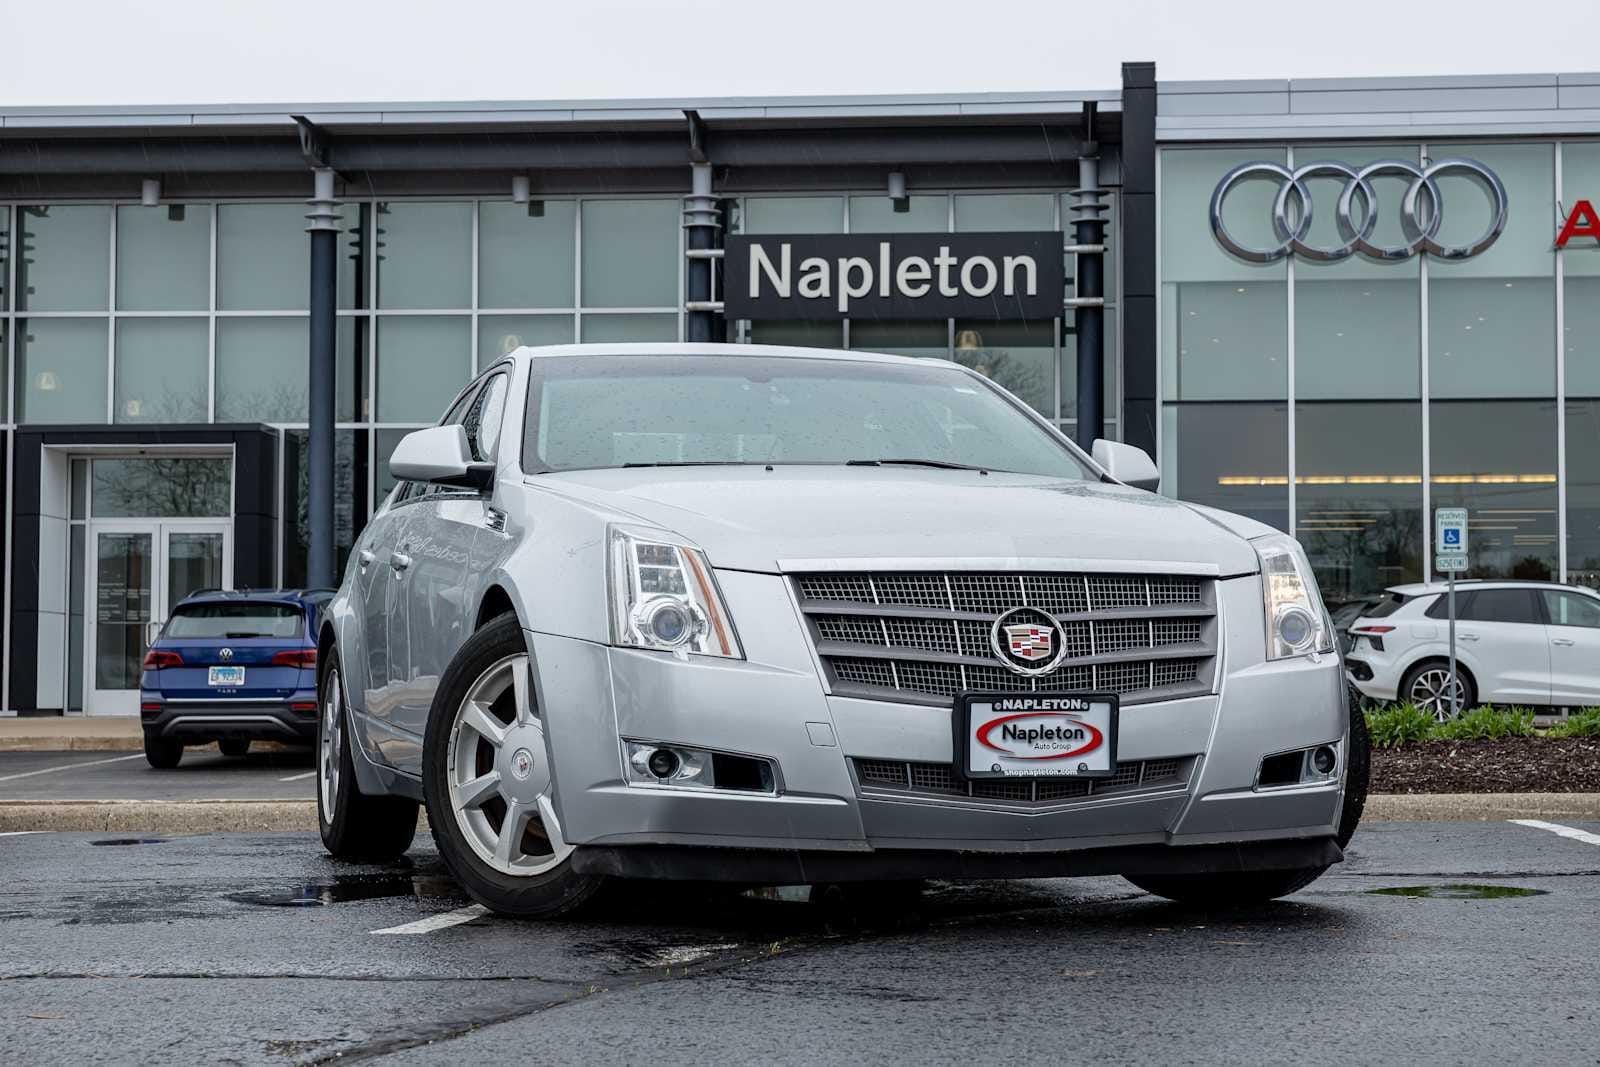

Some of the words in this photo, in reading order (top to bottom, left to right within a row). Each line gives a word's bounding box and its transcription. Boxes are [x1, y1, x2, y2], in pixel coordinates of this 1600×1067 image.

[749, 241, 1038, 313] Napleton
[1437, 511, 1465, 520] RESERVED
[1002, 699, 1081, 710] NAPLETON
[1002, 724, 1084, 743] Napleton
[1034, 742, 1051, 750] Auto
[1052, 742, 1072, 751] Group
[1004, 767, 1078, 777] shopnapleton.com
